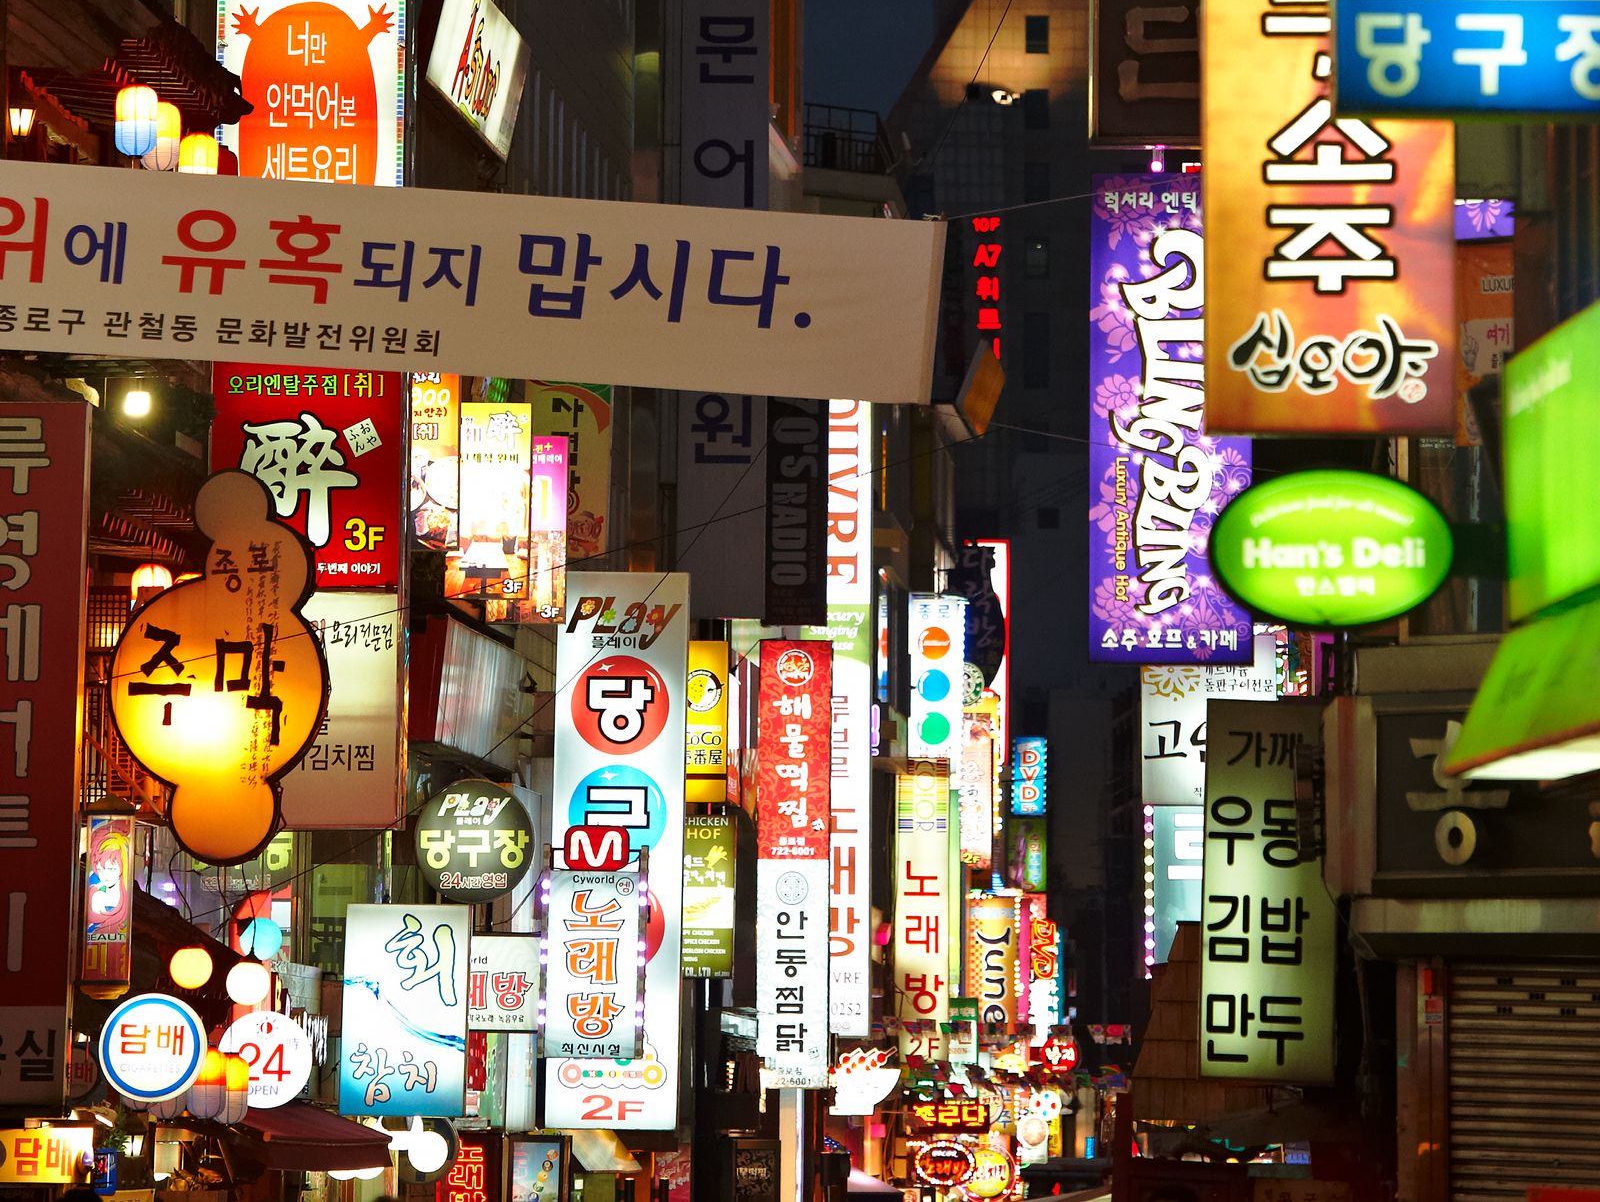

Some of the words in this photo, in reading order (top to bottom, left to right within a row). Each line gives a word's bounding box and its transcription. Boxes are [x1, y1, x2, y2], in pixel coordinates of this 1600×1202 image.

[287, 21, 326, 66] 너만
[266, 82, 356, 130] 안먹어본
[972, 217, 1000, 232] 10F
[162, 209, 343, 304] 유혹
[353, 239, 482, 307] 되지
[518, 233, 812, 329] 맙시다.
[104, 311, 198, 342] 관철동
[216, 317, 441, 357] 문화발전위원회
[228, 373, 337, 397] 오리엔탈주점
[1115, 457, 1129, 507] Luxury
[344, 517, 385, 550] 3F
[771, 483, 807, 585] RADIO
[1115, 511, 1130, 571] Antique
[1242, 537, 1344, 569] Han's
[1353, 537, 1426, 569] Deli
[502, 578, 523, 593] 3F
[1115, 575, 1129, 602] Hof
[541, 604, 560, 618] 3F
[128, 622, 286, 745] 주막
[774, 694, 812, 829] 해물떡찜
[1020, 750, 1041, 803] DVD
[420, 830, 529, 868] 당구장
[687, 828, 721, 839] HOF
[572, 874, 615, 885] Cyworld
[904, 861, 944, 1014] 노래방
[1207, 895, 1310, 965] 김밥
[385, 914, 456, 1007] 회
[563, 889, 626, 1040] 노래방
[775, 910, 808, 1053] 안동찜닭
[121, 1024, 185, 1056] 담배
[561, 1044, 621, 1055] 최신시설
[1206, 994, 1304, 1066] 만두
[238, 1042, 291, 1082] 24
[351, 1043, 437, 1106] 참치
[581, 1095, 645, 1121] 2F
[15, 1138, 73, 1176] 담배
